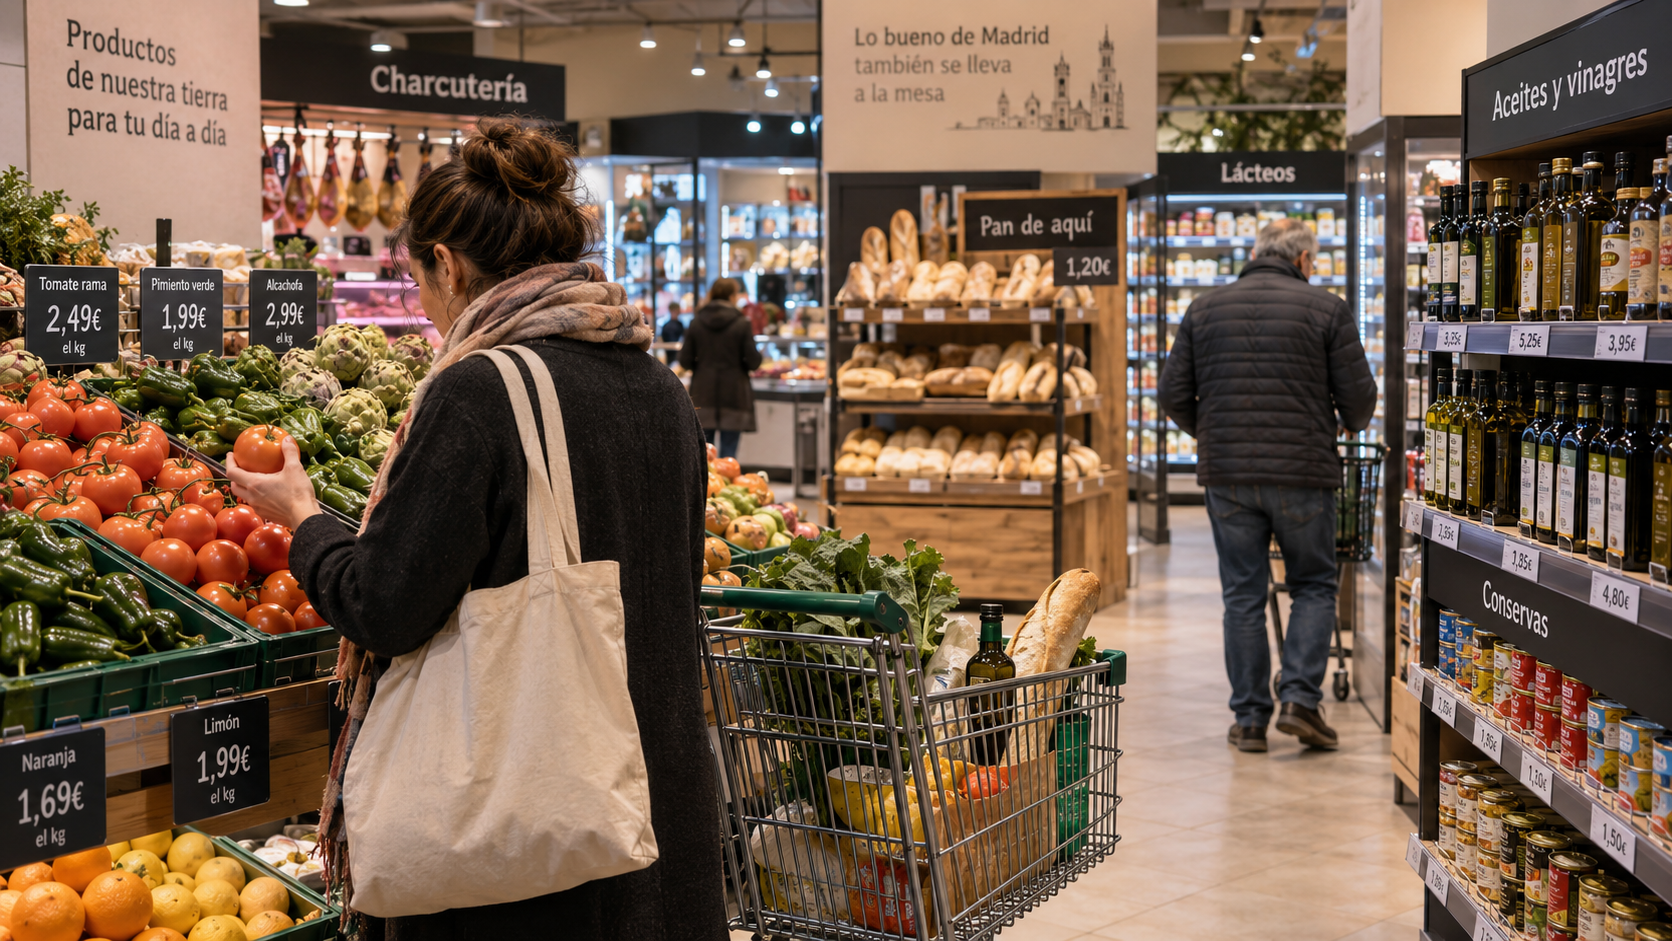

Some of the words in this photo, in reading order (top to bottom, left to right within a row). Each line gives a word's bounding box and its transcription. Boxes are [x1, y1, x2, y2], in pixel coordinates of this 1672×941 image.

[67, 18, 176, 66] Productos
[854, 27, 878, 47] Lo
[884, 26, 946, 47] bueno
[950, 25, 975, 46] de
[981, 25, 1050, 46] Madrid
[854, 54, 934, 75] también
[940, 59, 962, 75] se
[967, 53, 1012, 75] lleva
[66, 59, 94, 91] de
[100, 71, 176, 103] nuestra
[181, 80, 228, 112] tierra
[371, 64, 528, 104] Charcutería
[854, 87, 866, 103] a
[871, 82, 888, 103] la
[894, 87, 945, 103] mesa
[1492, 81, 1548, 122] Aceites
[1552, 77, 1563, 111] y
[1566, 48, 1648, 97] vinagres
[67, 107, 118, 136] para
[123, 110, 146, 137] tu
[151, 111, 181, 141] día
[185, 123, 196, 143] a
[200, 119, 227, 147] día
[1221, 161, 1296, 183] Lácteos
[980, 215, 1014, 237] Pan
[1020, 213, 1044, 235] de
[1050, 210, 1094, 241] aquí
[1066, 256, 1111, 280] 1,20€
[38, 276, 79, 291] Tomate
[81, 280, 107, 291] rama
[151, 277, 190, 291] Pimiento
[191, 278, 215, 291] verde
[266, 278, 303, 291] Alcachofa
[46, 304, 102, 337] 2,49€
[162, 303, 207, 334] 1,99€
[265, 302, 305, 329] 2,99€
[62, 340, 72, 354] el
[74, 340, 86, 357] kg
[173, 337, 181, 350] el
[183, 337, 194, 353] kg
[275, 332, 283, 344] el
[284, 332, 293, 347] kg
[1518, 332, 1542, 351] 5,25€
[1608, 334, 1637, 356] 3,95€
[1483, 580, 1549, 638] Conservas
[1602, 583, 1630, 611] 4,80€
[204, 714, 240, 735] Limón
[21, 746, 76, 774] Naranja
[197, 744, 251, 786] 1,99€
[17, 780, 85, 828] 1,69€
[210, 789, 220, 805] el
[222, 786, 236, 804] kg
[35, 828, 48, 848] el
[51, 826, 66, 847] kg
[1602, 822, 1628, 857] 1,50€
